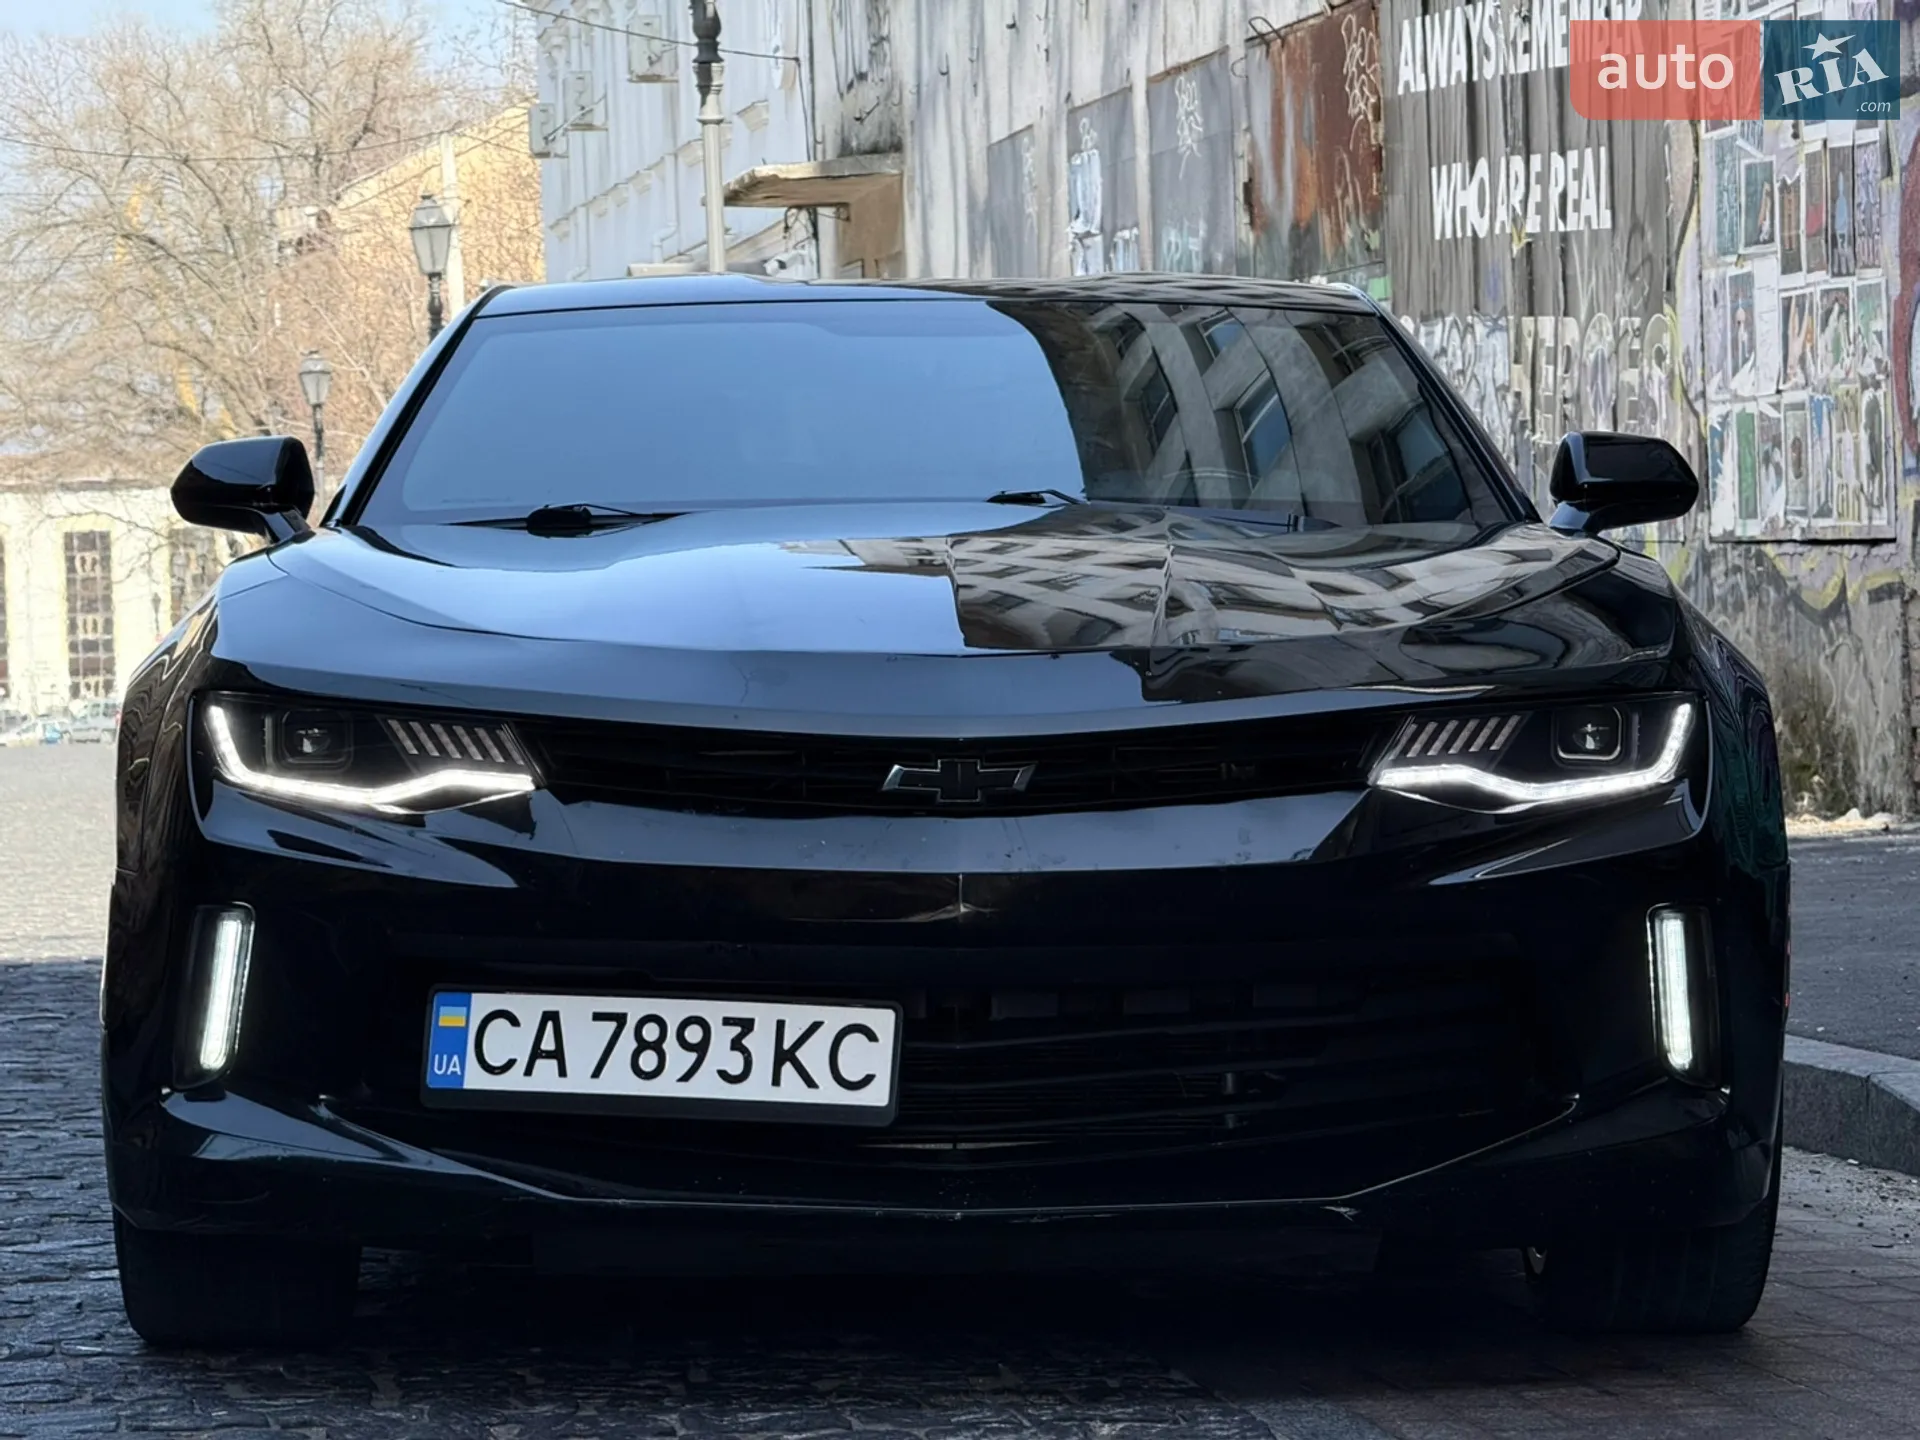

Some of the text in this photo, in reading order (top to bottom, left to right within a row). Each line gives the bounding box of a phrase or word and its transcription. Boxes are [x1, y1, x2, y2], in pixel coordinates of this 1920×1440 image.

[1398, 1, 1502, 95] ALWAYS
[1431, 146, 1612, 240] WHO ARE REAL
[434, 1054, 461, 1075] UA
[474, 1009, 879, 1091] CA 7893 KC
